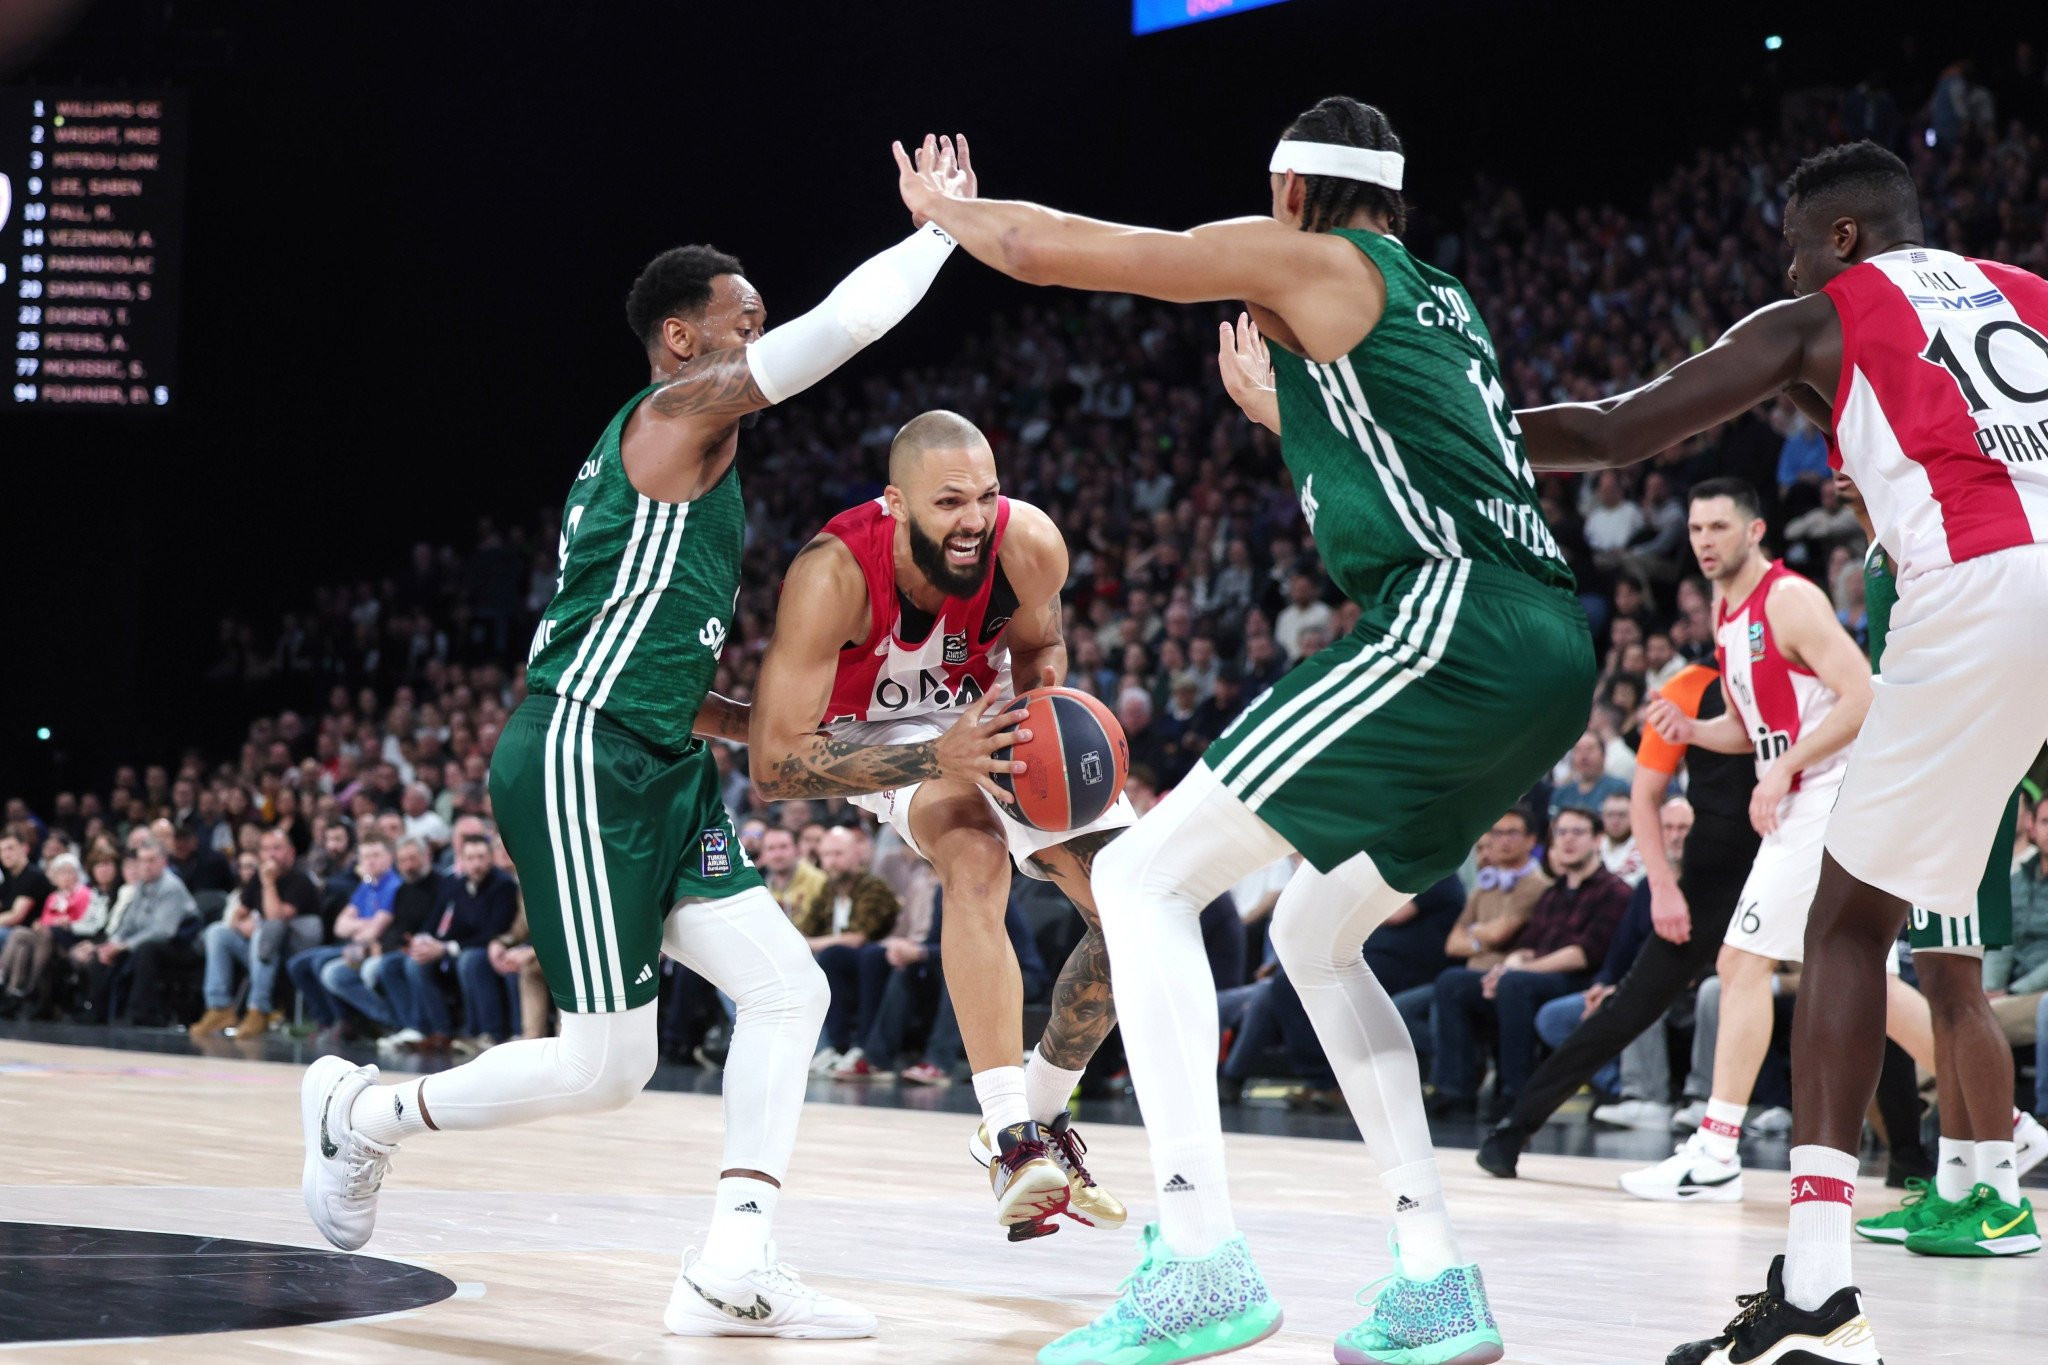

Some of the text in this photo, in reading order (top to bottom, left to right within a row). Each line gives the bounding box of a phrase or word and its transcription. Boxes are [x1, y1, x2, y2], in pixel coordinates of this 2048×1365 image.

[24, 203, 46, 221] 10
[1913, 270, 1966, 291] FALL
[1909, 289, 2004, 310] FMS
[16, 357, 39, 377] 77
[1921, 320, 2048, 413] 10
[704, 833, 725, 852] 25
[1733, 898, 1761, 934] 16
